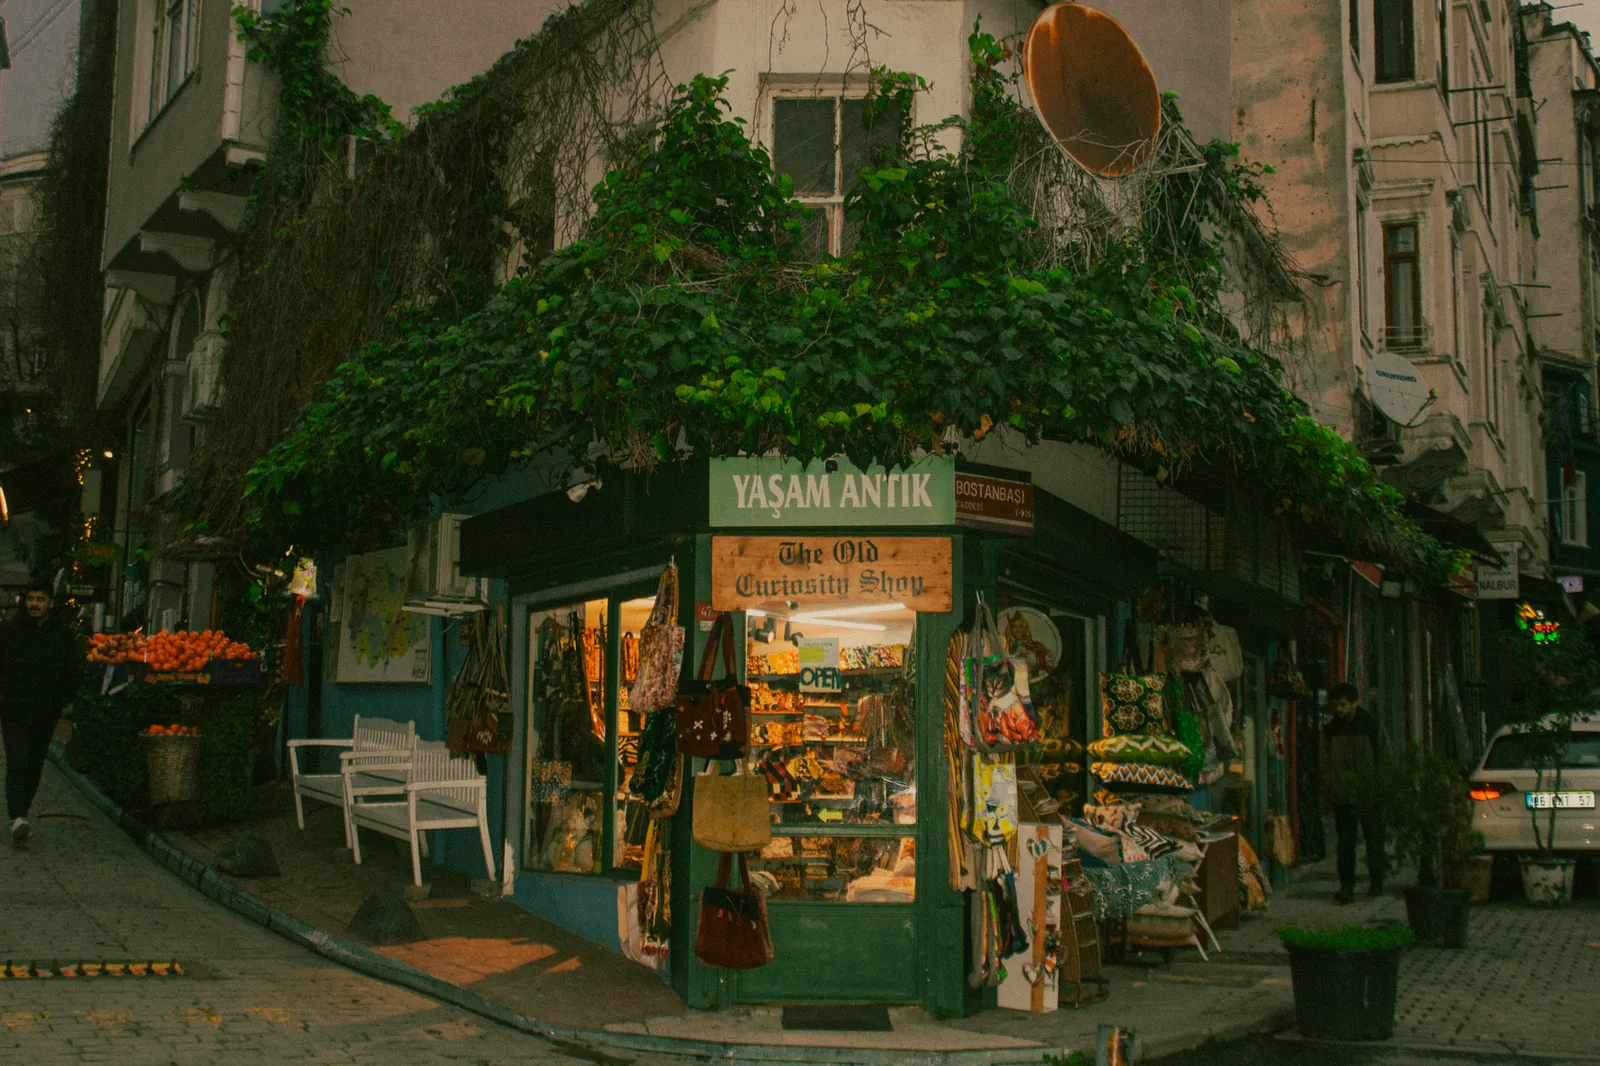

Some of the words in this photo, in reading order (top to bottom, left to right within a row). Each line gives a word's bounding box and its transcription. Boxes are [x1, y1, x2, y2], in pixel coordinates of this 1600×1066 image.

[732, 473, 830, 519] YAŞAM
[955, 480, 1025, 508] BOSTANBAŞI
[778, 541, 824, 570] The
[832, 540, 879, 564] Old
[735, 572, 849, 600] Curiosity
[859, 569, 925, 598] Shop
[800, 667, 842, 690] OPEN
